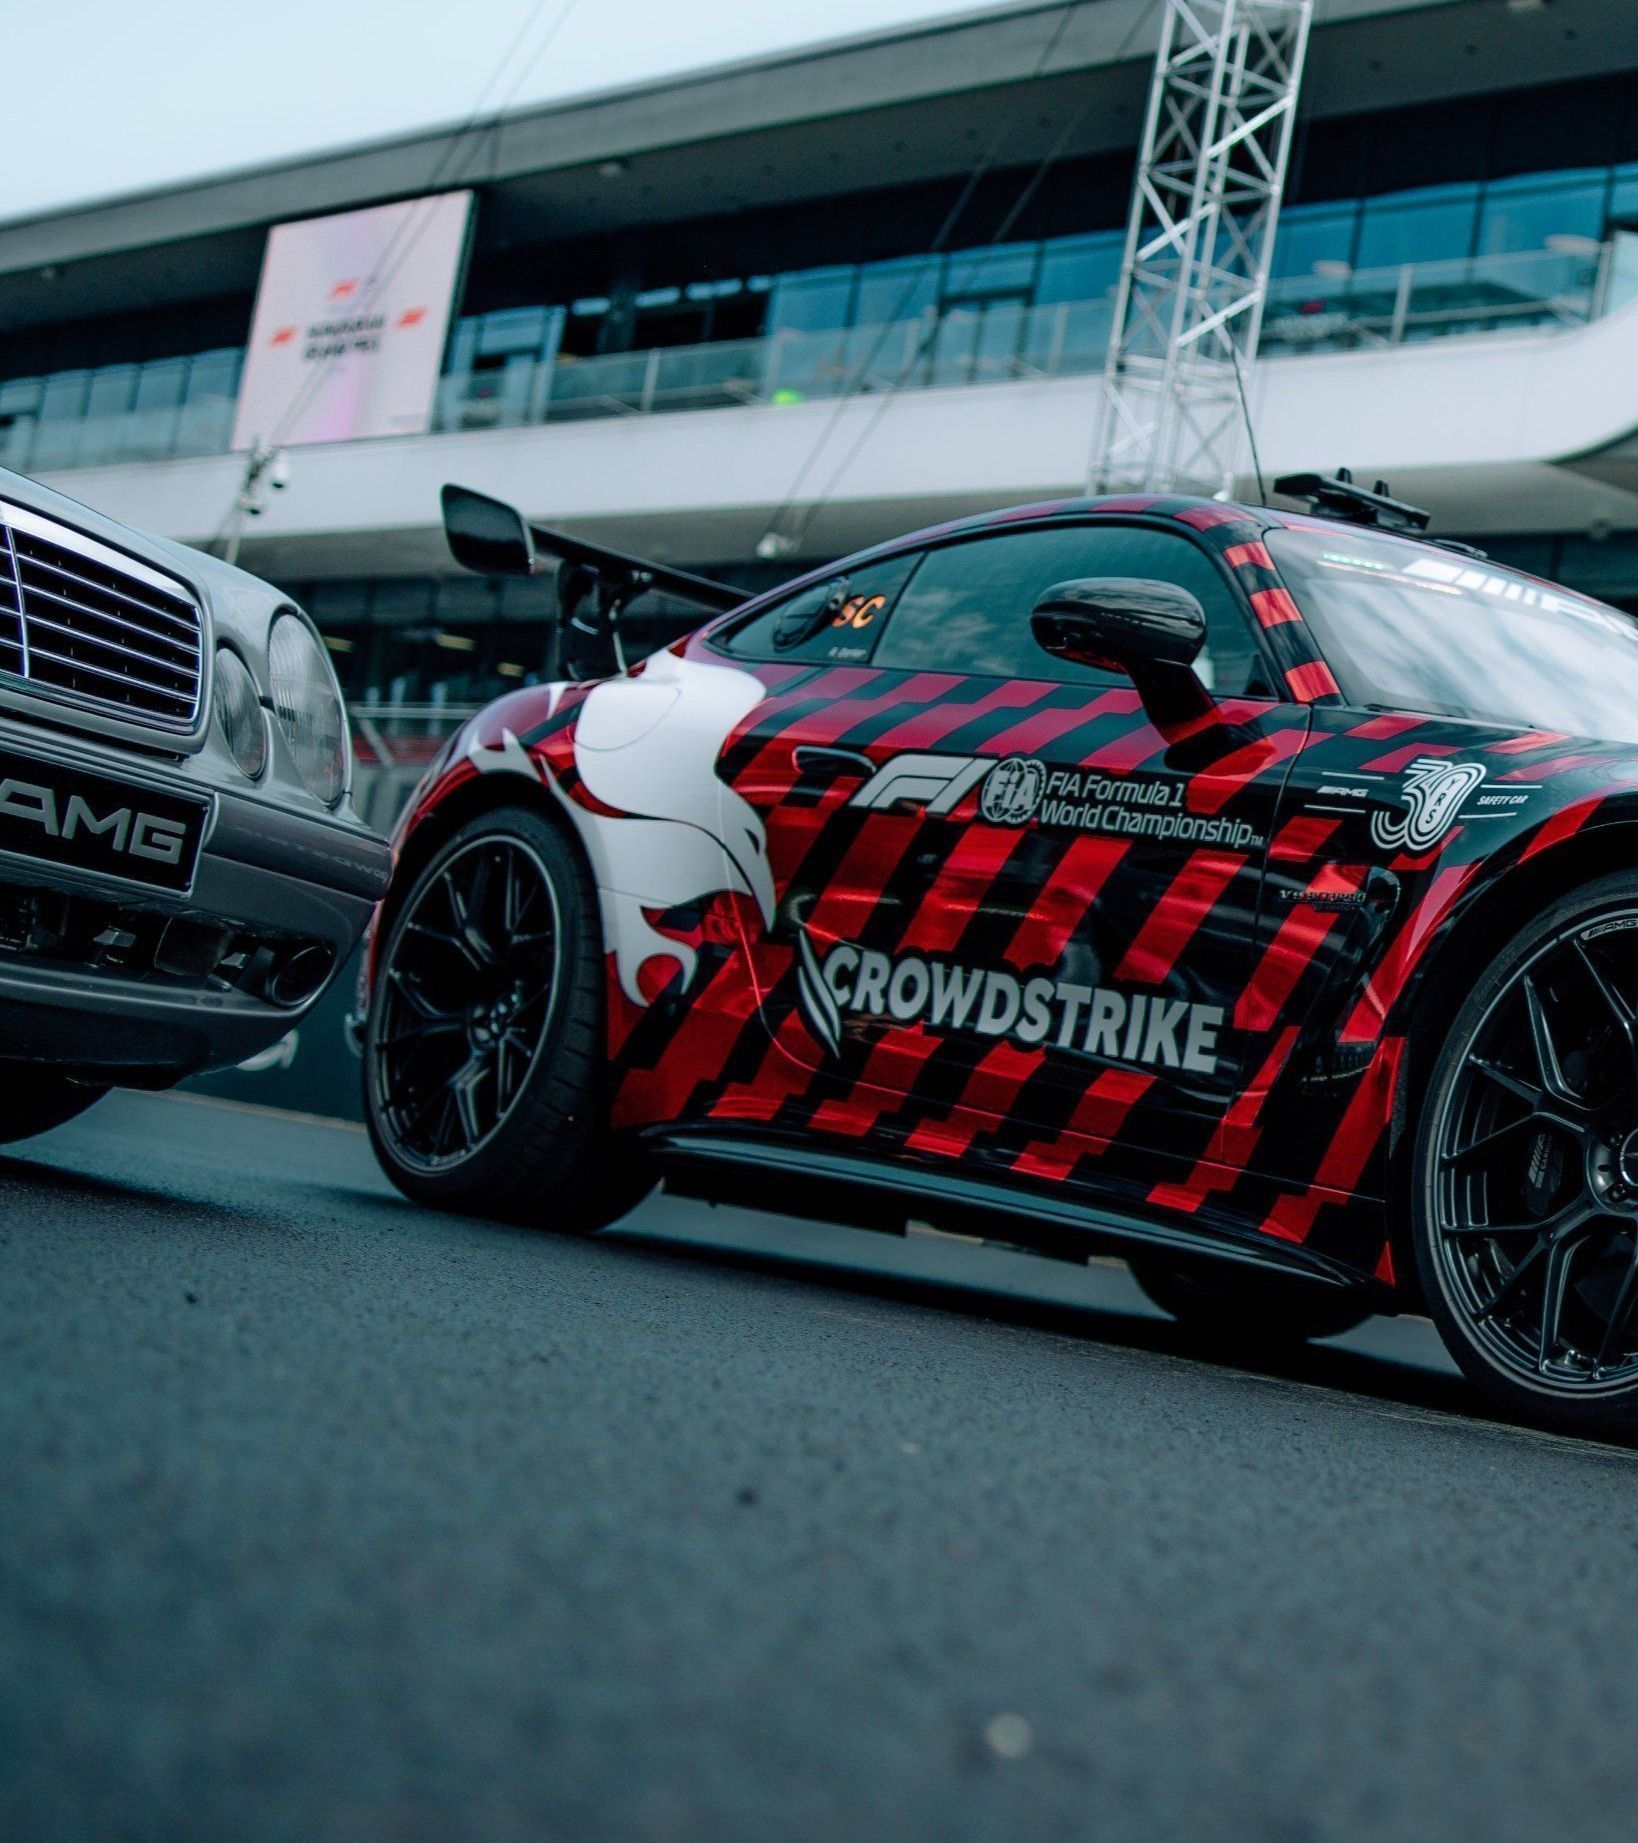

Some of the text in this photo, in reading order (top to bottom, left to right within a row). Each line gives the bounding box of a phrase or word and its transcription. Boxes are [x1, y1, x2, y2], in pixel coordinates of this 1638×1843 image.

[832, 595, 886, 628] SC
[1047, 771, 1185, 807] FIA Formula 1
[1477, 795, 1529, 806] SAFETY CAR
[0, 778, 187, 865] AMG
[1040, 799, 1099, 828] World
[822, 944, 1225, 1075] CROWDSTRIKE
